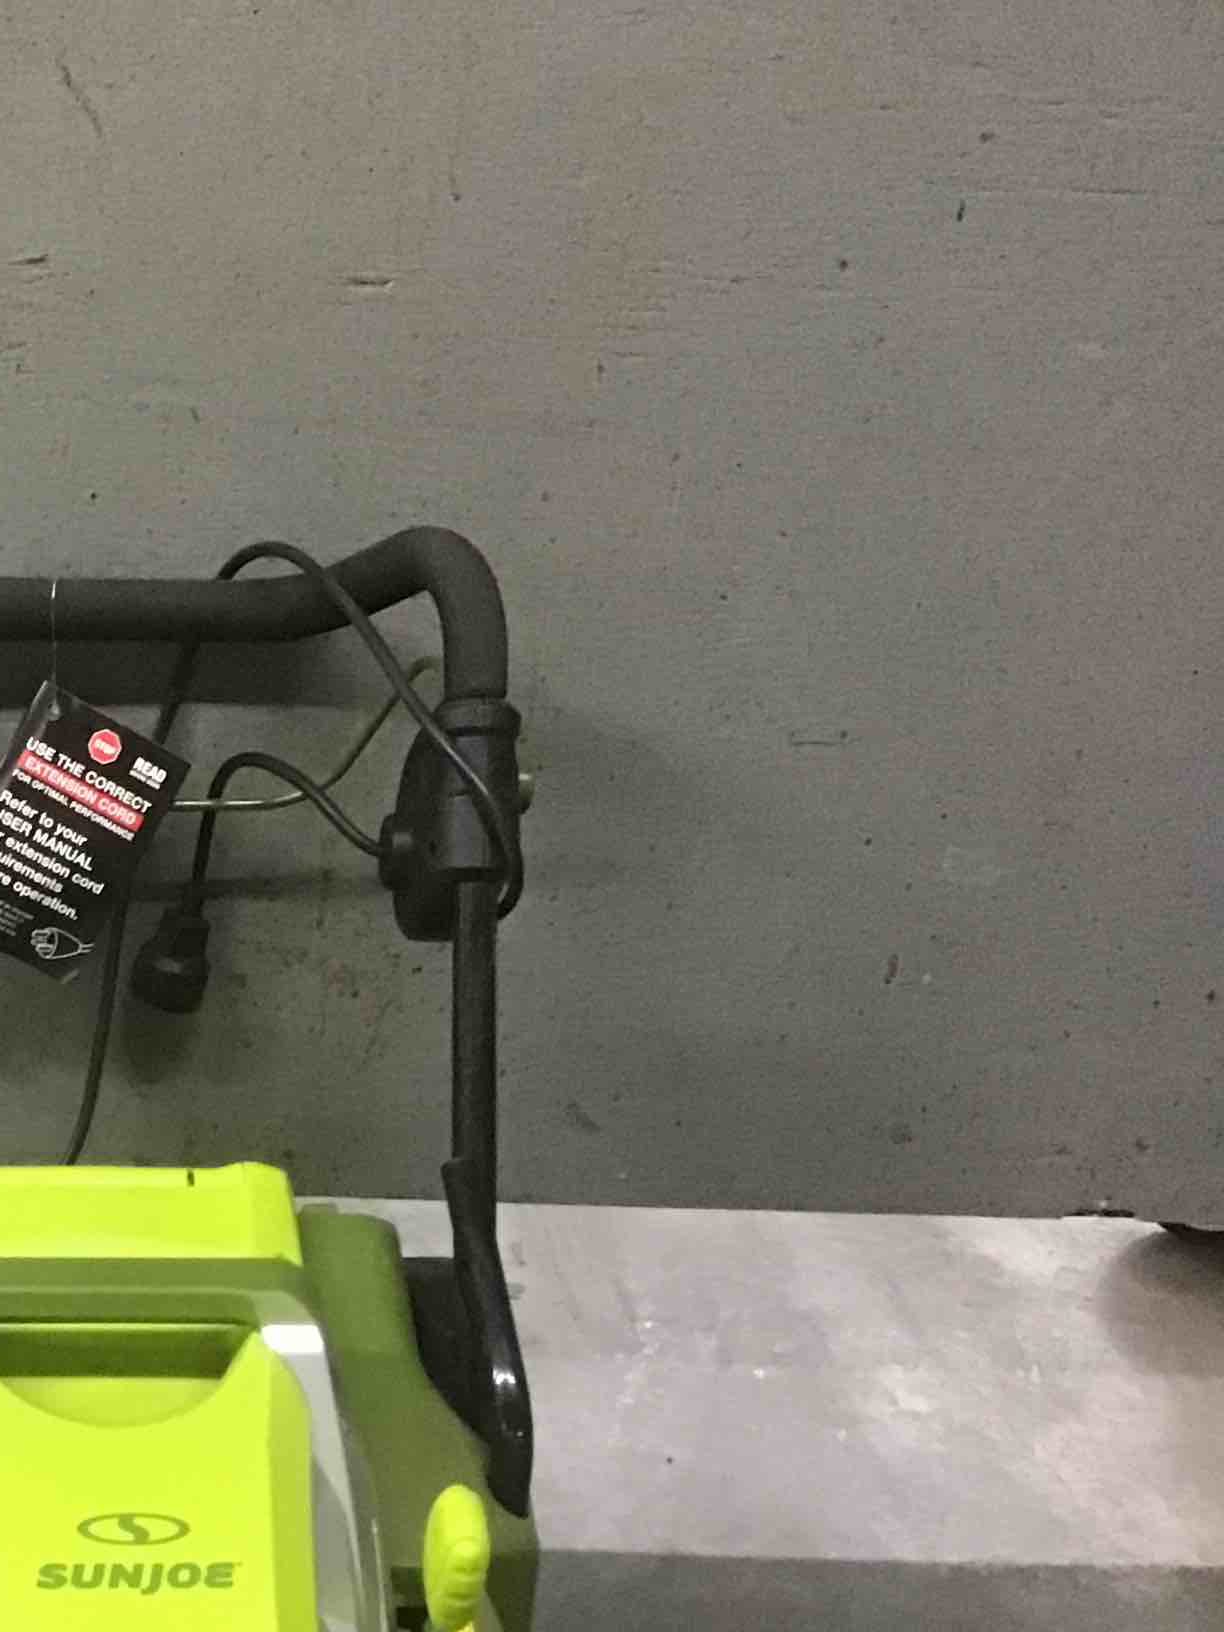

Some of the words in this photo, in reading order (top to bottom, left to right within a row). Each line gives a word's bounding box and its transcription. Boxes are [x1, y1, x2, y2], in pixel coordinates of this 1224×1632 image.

[24, 755, 98, 804] EXTENSION
[98, 798, 136, 825] CORD
[26, 736, 56, 762] USE
[56, 753, 85, 778] THE
[85, 770, 152, 813] CORRECT
[133, 756, 167, 783] READ
[0, 789, 38, 818] Refer
[39, 812, 54, 828] to
[54, 824, 88, 846] your
[12, 768, 32, 784] FOR
[32, 779, 68, 806] OPTIMAL
[69, 800, 135, 841] PERFORMANCE
[5, 837, 71, 878] extension
[71, 873, 105, 895] cord
[32, 829, 93, 871] MANUAL
[13, 881, 78, 920] operation.
[36, 1561, 237, 1595] SUNJOE
